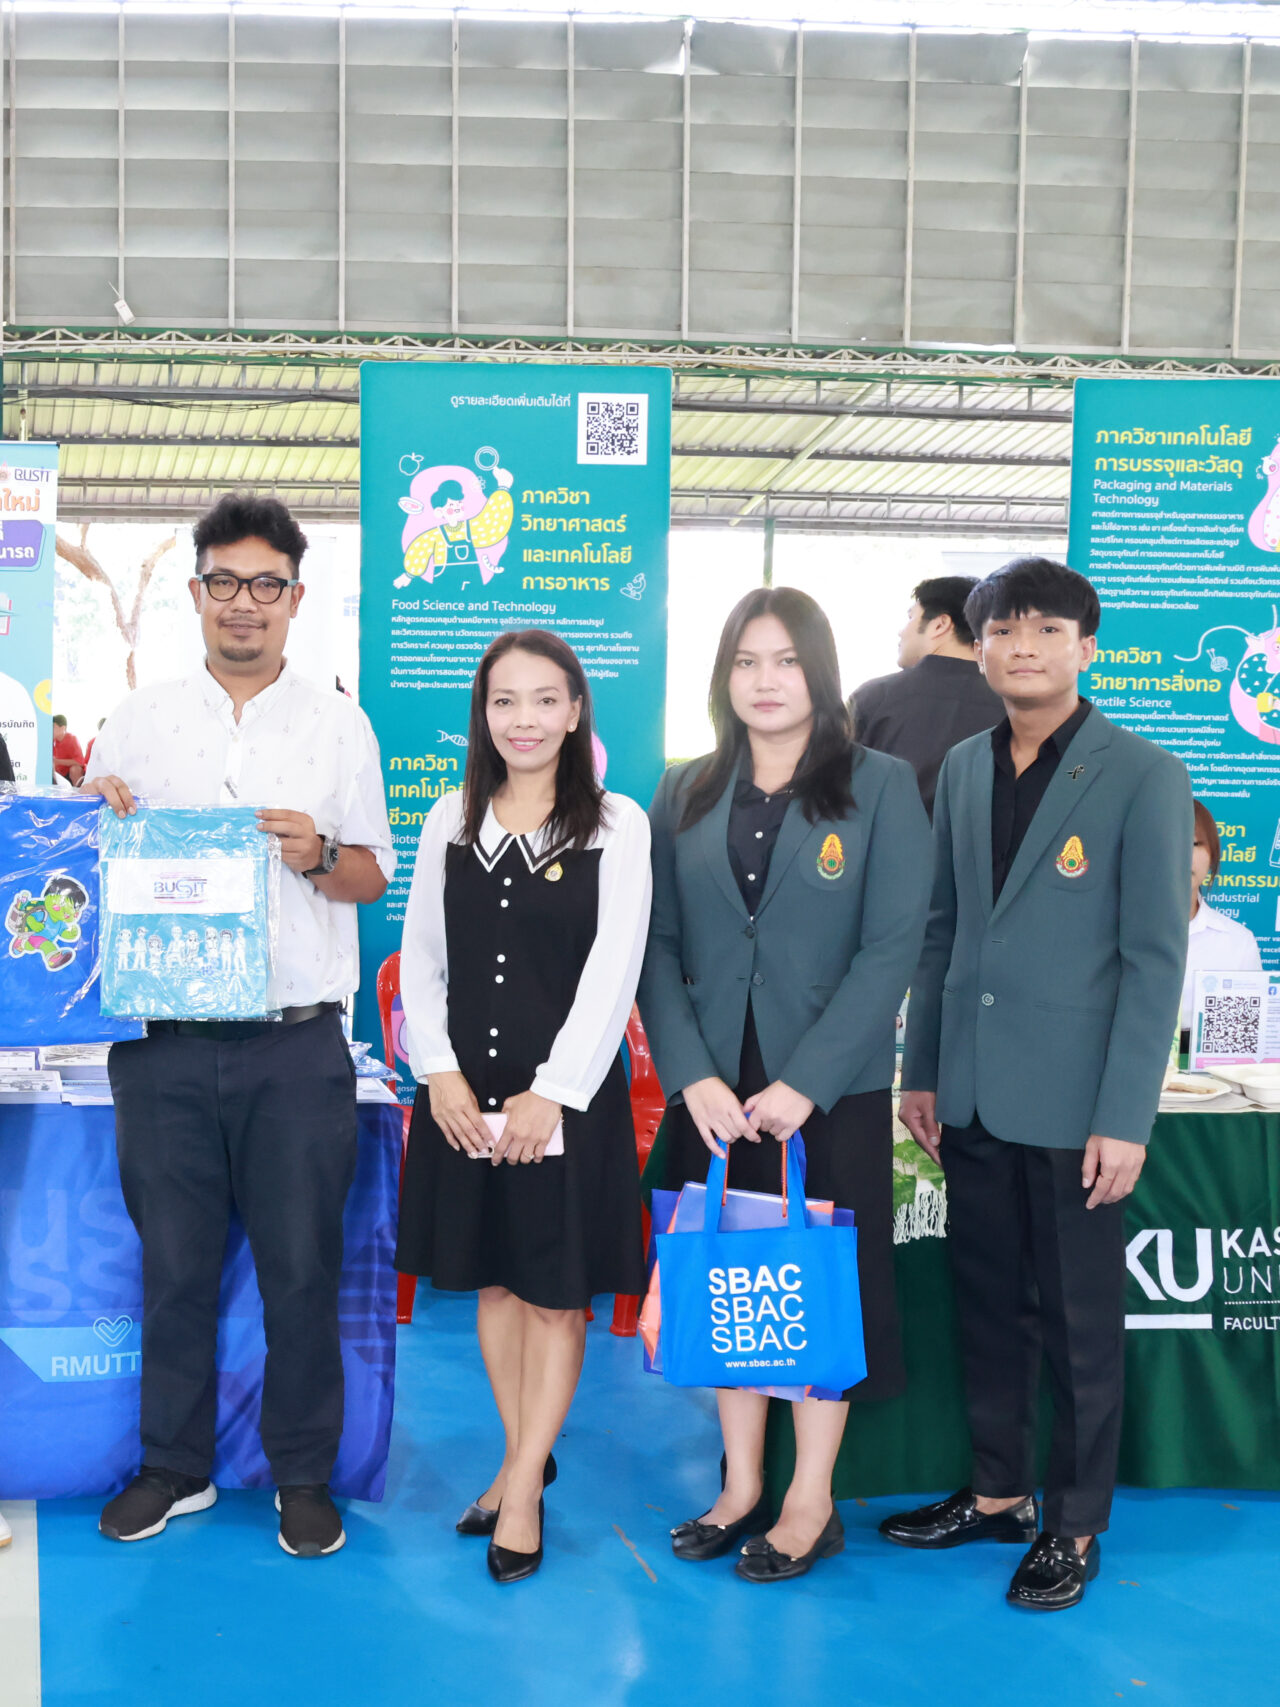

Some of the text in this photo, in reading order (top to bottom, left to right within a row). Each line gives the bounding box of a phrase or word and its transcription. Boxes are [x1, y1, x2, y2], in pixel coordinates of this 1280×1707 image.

[450, 393, 571, 408] ดูรายละเอียดเพิ่มเติมได้ที่
[1096, 425, 1252, 446] ภาควิชาเทคโนโลยี
[1095, 455, 1243, 479] การบรรจุและวัสดุ
[1093, 479, 1233, 493] Packaging and Materials
[521, 487, 590, 505] ภาควิชา
[1093, 493, 1159, 507] Technology
[521, 515, 627, 532] วิทยาศาสตร์
[522, 543, 632, 564] และเทคโนโลยี
[522, 576, 610, 591] การอาหาร
[391, 599, 556, 614] Food Science and Technology
[1092, 647, 1162, 664] ภาควิชา
[1090, 669, 1222, 692] วิทยาการสิ่งทอ
[1090, 696, 1172, 708] Textile Science
[389, 754, 458, 771] ภาควิชา
[389, 778, 465, 798] เทคโนโล
[1216, 822, 1246, 837] วิชา
[1125, 1228, 1214, 1302] KU
[708, 1263, 803, 1295] SBAC
[710, 1293, 805, 1325] SBAC
[1223, 1316, 1280, 1330] FACULT
[711, 1323, 808, 1353] SBAC
[51, 1351, 141, 1377] RMUTT
[725, 1358, 796, 1368] www.sbac.ac.th
